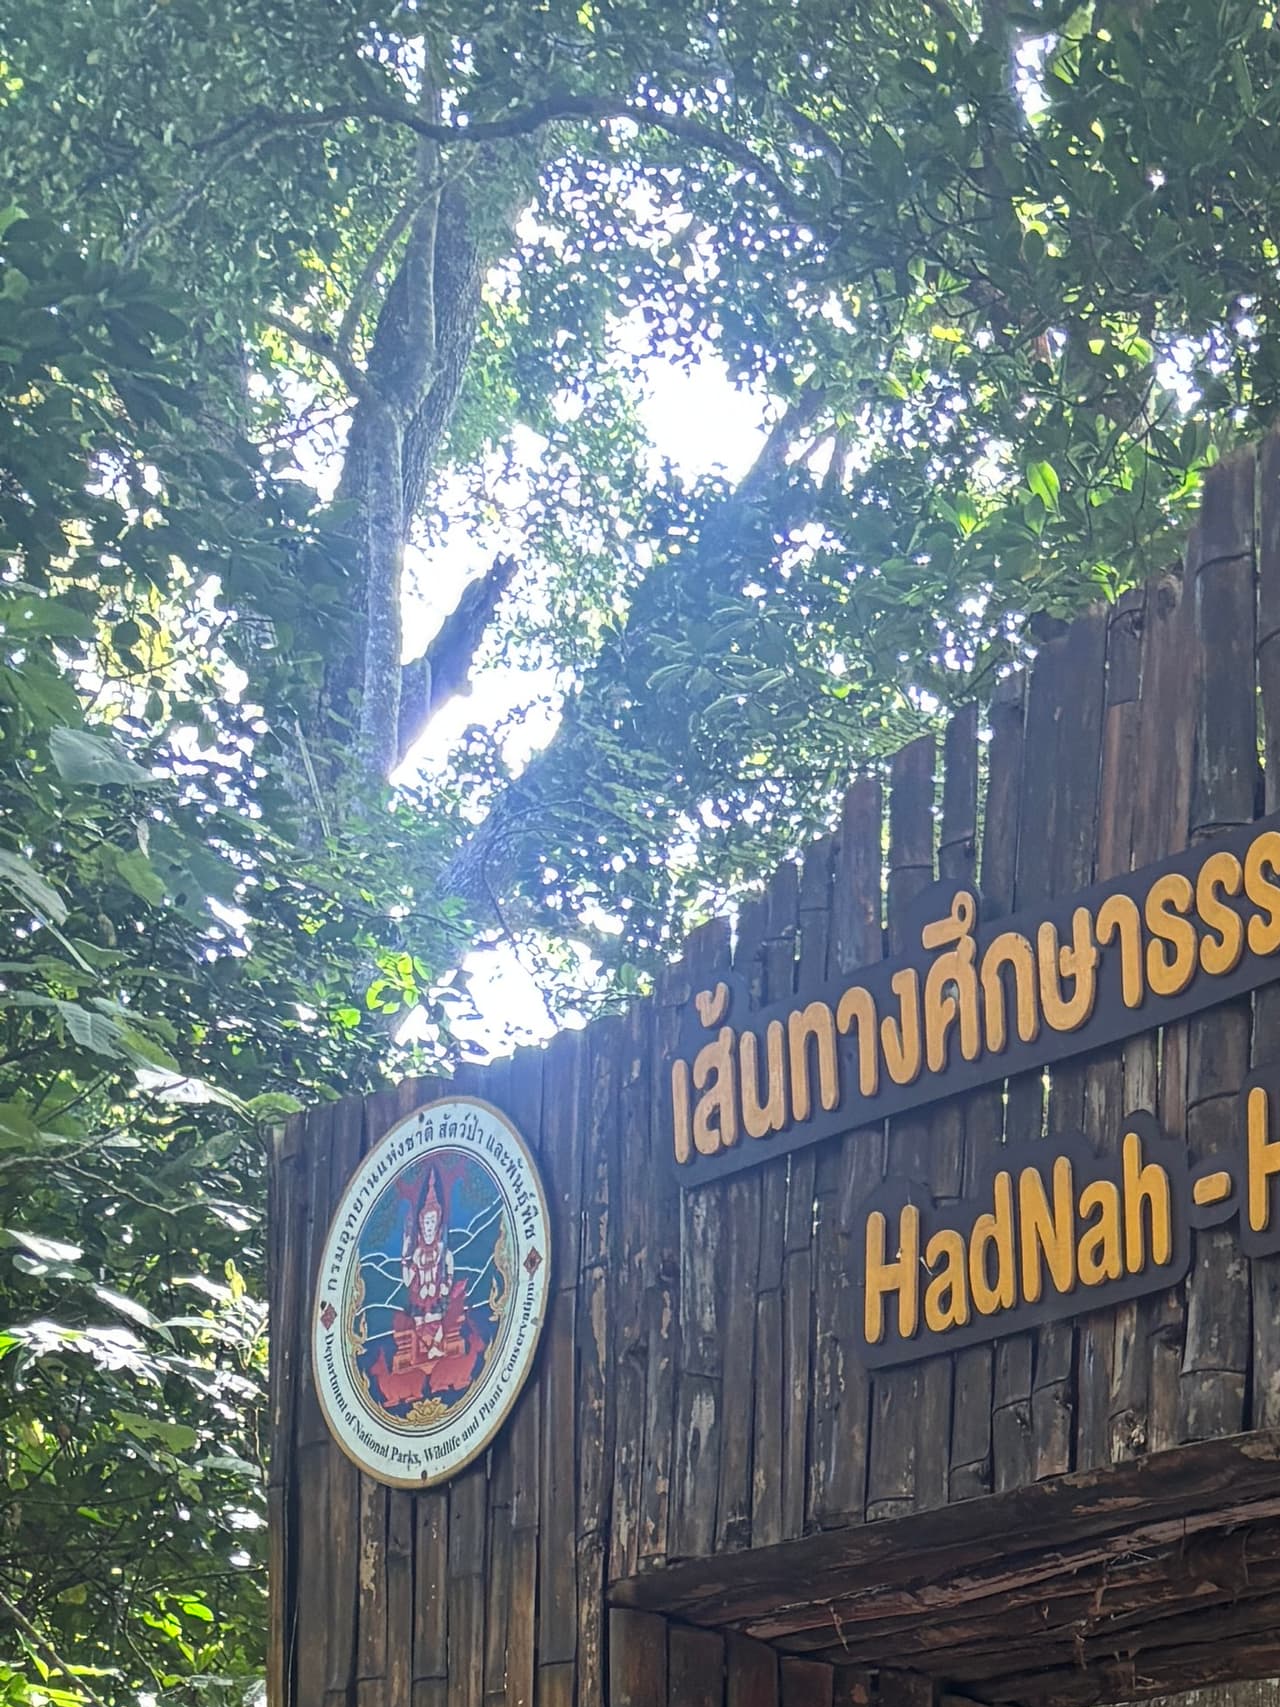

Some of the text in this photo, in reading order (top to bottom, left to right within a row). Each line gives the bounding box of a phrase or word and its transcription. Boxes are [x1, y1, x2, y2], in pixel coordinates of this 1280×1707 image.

[327, 1119, 434, 1291] กรมอุทยานแห่งชาติ
[439, 1113, 484, 1145] สัตว์ป่า
[864, 1132, 1171, 1345] HadNah
[323, 1332, 348, 1413] Department
[345, 1412, 357, 1426] of
[352, 1419, 390, 1458] National
[423, 1435, 460, 1462] Wildlife
[461, 1416, 480, 1441] and
[478, 1384, 503, 1422] Plant
[501, 1282, 535, 1383] Conservation
